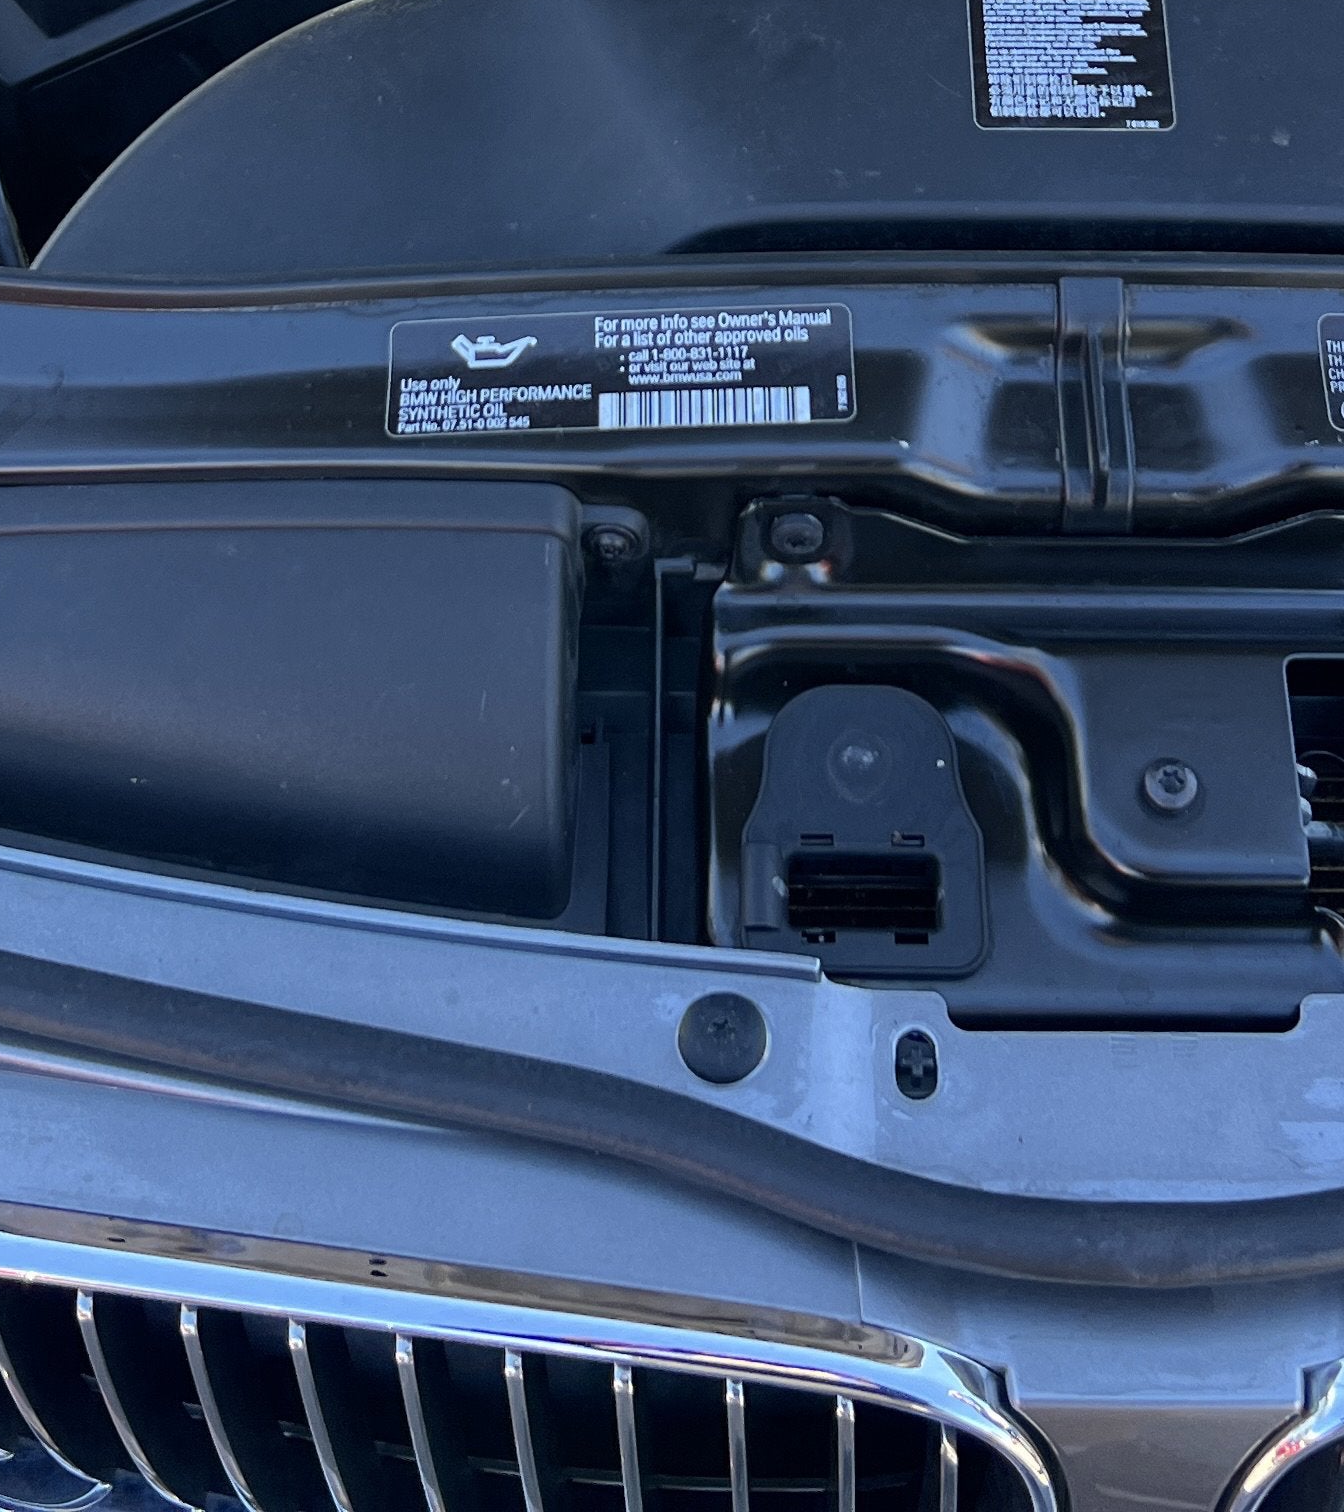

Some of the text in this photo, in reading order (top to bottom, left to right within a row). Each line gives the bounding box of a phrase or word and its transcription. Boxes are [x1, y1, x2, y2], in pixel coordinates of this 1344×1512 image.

[595, 316, 619, 332] For
[621, 317, 658, 331] more
[690, 316, 716, 329] see
[718, 311, 776, 328] Owner's
[779, 308, 831, 326] Manual
[595, 326, 809, 348] For a list of other approved oils
[628, 345, 748, 362] call 1-800-831-1117
[628, 357, 756, 373] or visit our web site at
[401, 376, 460, 392] Use only
[628, 370, 742, 385] www.bmwusa.com
[400, 384, 592, 406] BMW HIGH PERFORMANCE
[399, 402, 507, 421] SYNTHETIC OIL
[398, 421, 420, 434] Part
[422, 419, 441, 432] No.
